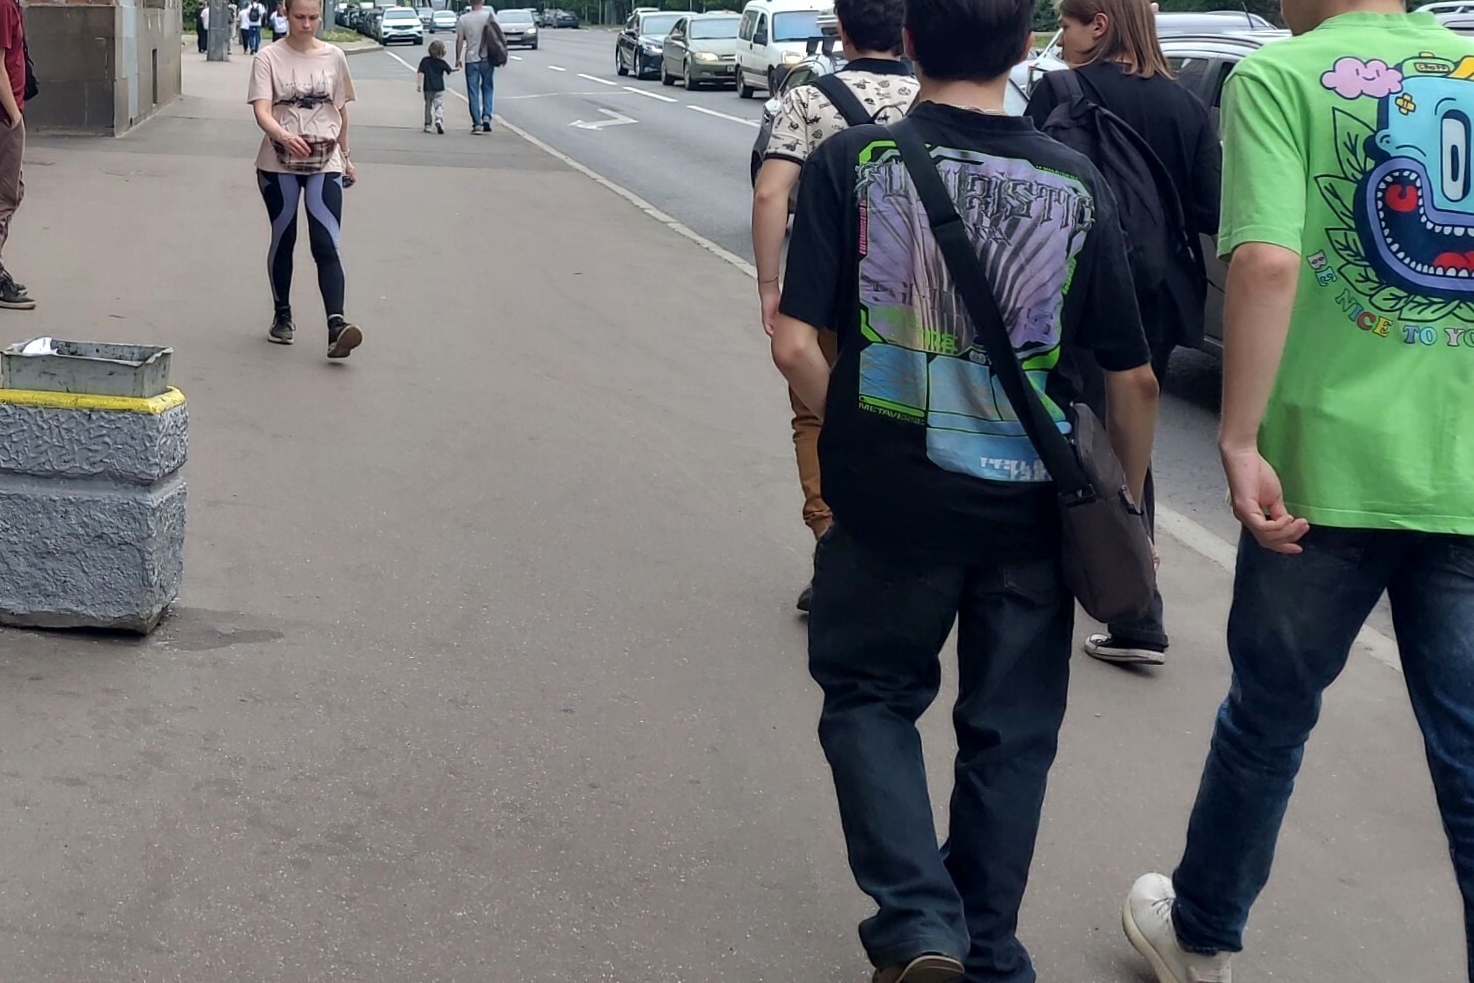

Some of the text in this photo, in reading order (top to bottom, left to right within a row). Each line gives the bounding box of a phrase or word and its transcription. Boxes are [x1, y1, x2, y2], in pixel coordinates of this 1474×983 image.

[1306, 250, 1338, 287] BE
[1335, 288, 1393, 338] NICE
[1402, 325, 1438, 346] TO
